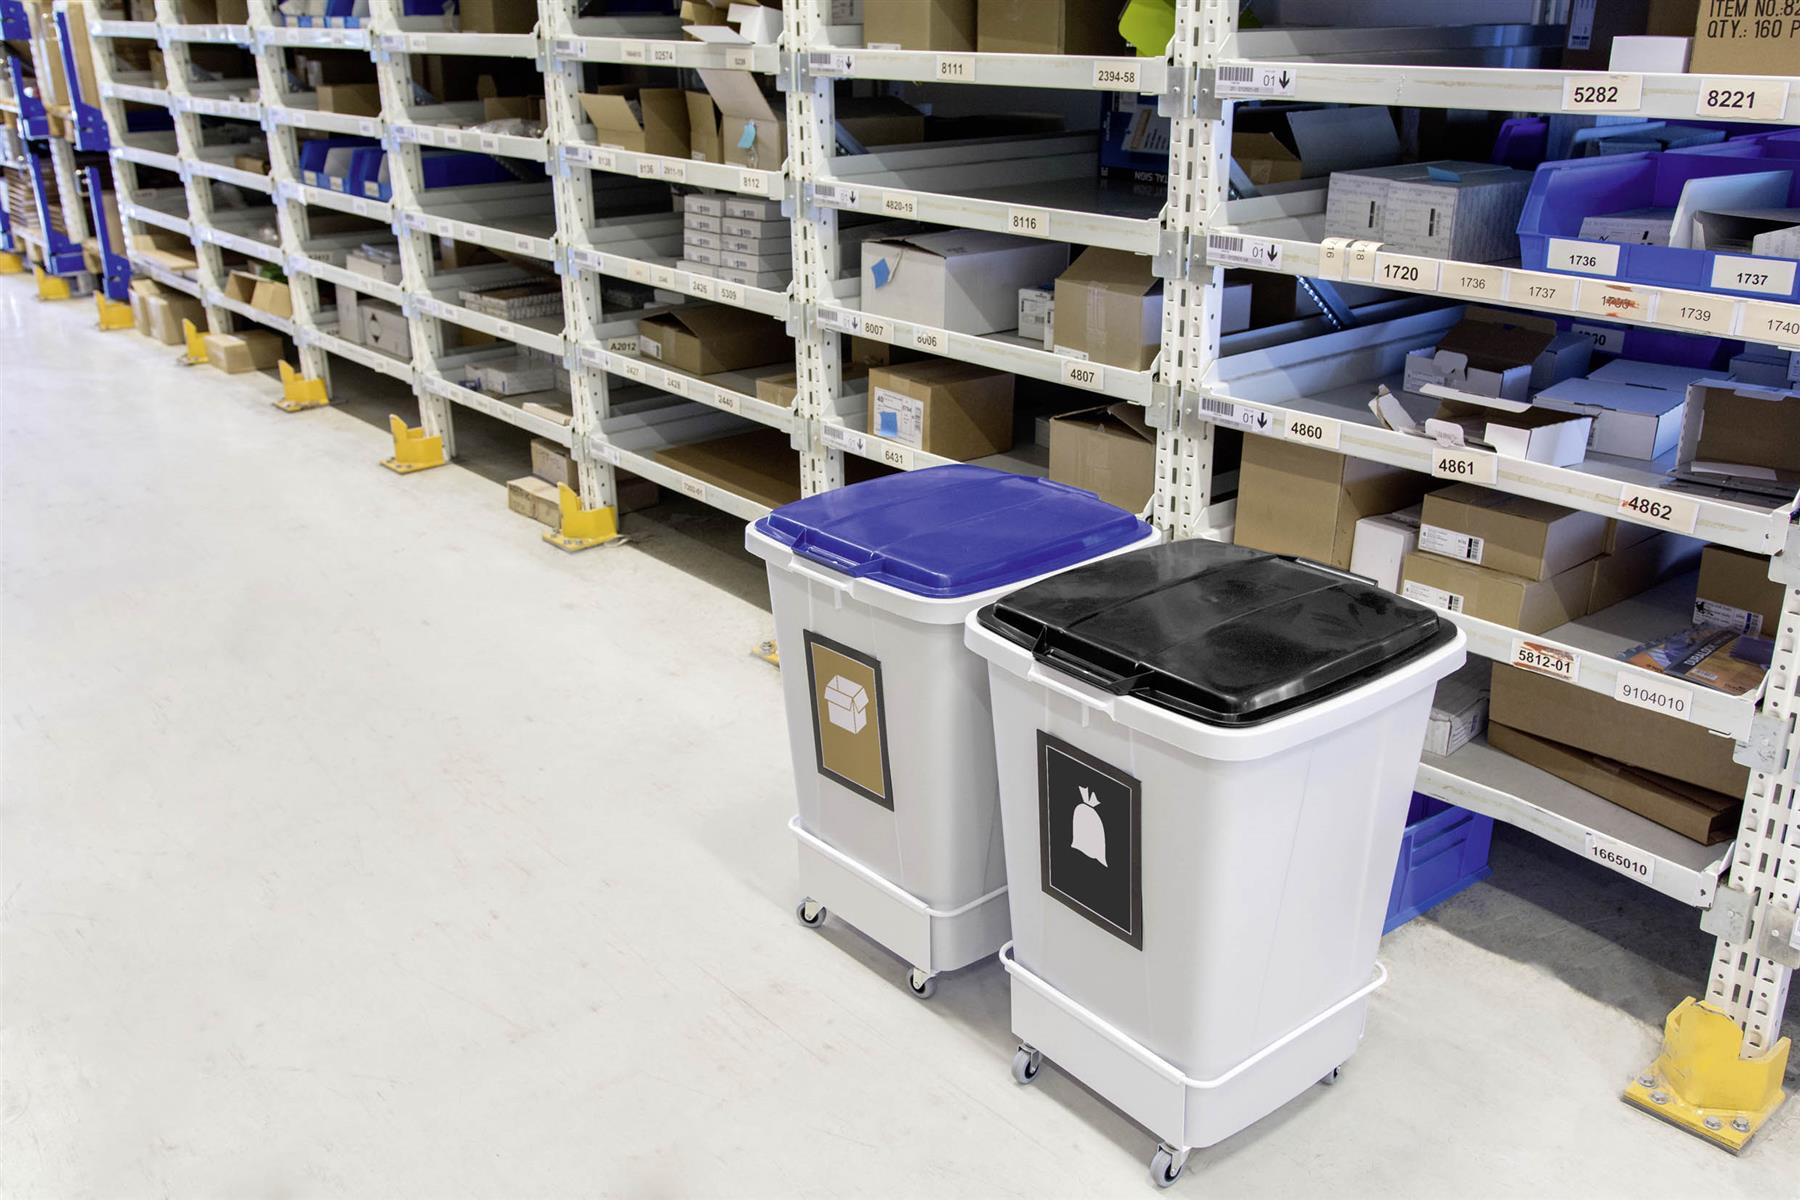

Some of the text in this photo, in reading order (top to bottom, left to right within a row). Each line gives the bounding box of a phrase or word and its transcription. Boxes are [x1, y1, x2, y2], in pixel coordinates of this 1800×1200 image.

[1710, 0, 1748, 17] ITEM
[1707, 20, 1747, 38] QTY.:
[1755, 20, 1782, 38] 160
[941, 62, 963, 75] 8111
[1098, 70, 1135, 83] 2394-58
[1573, 86, 1618, 103] 5282
[1707, 89, 1755, 109] 8221
[885, 199, 913, 213] 4820-19
[1013, 215, 1037, 230] 8116
[1252, 246, 1264, 259] 01
[1569, 254, 1597, 267] 1736
[1384, 264, 1419, 282] 1720
[1737, 272, 1769, 286] 1737
[1461, 276, 1486, 290] 1736
[1529, 286, 1556, 299] 1737
[1680, 306, 1712, 322] 1739
[864, 322, 884, 336] 8007
[1767, 319, 1800, 335] 1740
[610, 342, 637, 352] A2012
[1070, 368, 1095, 384] 4807
[1290, 421, 1323, 440] 4860
[884, 450, 904, 465] 6431
[1438, 458, 1474, 475] 4861
[1627, 495, 1673, 521] 4862
[1517, 649, 1572, 674] 5812-01
[1621, 683, 1685, 713] 9104010
[1591, 845, 1648, 876] 1665010
